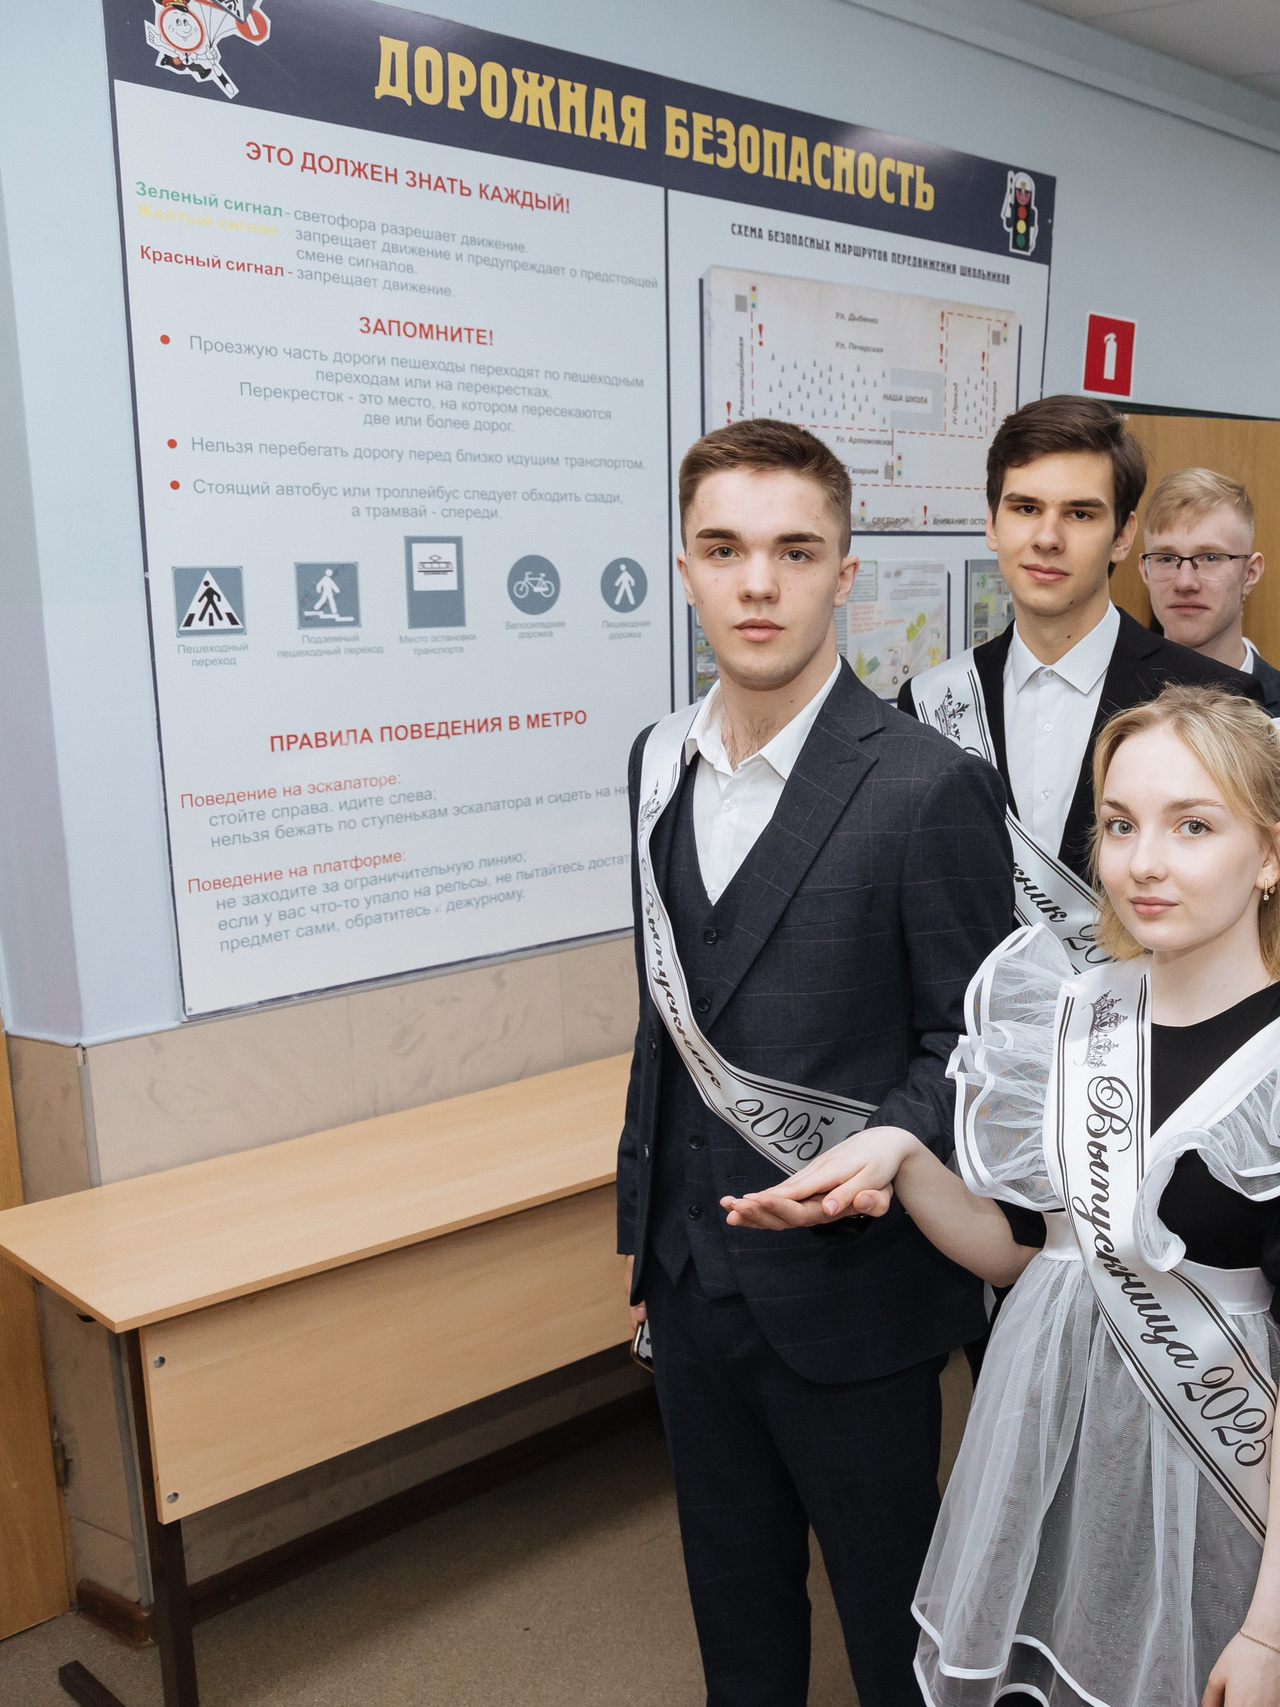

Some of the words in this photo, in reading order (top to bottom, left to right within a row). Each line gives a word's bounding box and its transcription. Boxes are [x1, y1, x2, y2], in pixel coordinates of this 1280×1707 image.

[374, 36, 648, 151] ДОРОЖНАЯ
[664, 104, 936, 212] БЕЗОПАСНОСТЬ
[245, 141, 293, 166] ЭТО
[300, 151, 397, 184] ДОЛЖЕН
[405, 169, 471, 196] ЗНАТЬ
[478, 182, 570, 213] КАЖДЫЙ!
[135, 180, 218, 207] Зеленый
[223, 198, 282, 217] сигнал
[293, 209, 375, 232] светофора
[381, 222, 456, 241] разрешает
[136, 201, 212, 226] Желтый
[218, 218, 278, 236] сигнал
[295, 229, 377, 250] запрещает
[380, 241, 450, 260] движение
[454, 251, 463, 261] и
[467, 253, 565, 275] предупреждает
[568, 267, 577, 277] о
[580, 269, 658, 288] предстоящей
[296, 249, 343, 265] смене
[348, 256, 417, 274] сигналов.
[730, 222, 763, 239] СХЕМА
[767, 229, 830, 251] БЕЗОПАСНЫХ
[834, 241, 887, 262] МАРШРУТОВ
[891, 252, 956, 274] ПЕРЕДВИЖЕНИЯ
[959, 265, 1010, 284] ШКОЛЬНИКОВ
[140, 244, 220, 269] Красный
[225, 260, 283, 276] сигнал
[296, 269, 378, 287] запрещает
[359, 316, 492, 345] ЗАПОМНИТЕ!
[189, 334, 278, 359] Проезжую
[282, 347, 328, 361] часть
[332, 351, 386, 366] дороги
[390, 356, 465, 374] пешеходы
[469, 363, 540, 379] переходят
[544, 369, 560, 380] по
[563, 371, 644, 387] пешеходным
[239, 381, 344, 402] Перекресток
[358, 393, 383, 405] это
[440, 399, 456, 410] на
[461, 400, 517, 415] котором
[521, 404, 611, 419] пересекаются
[315, 370, 399, 387] переходам
[404, 377, 431, 388] или
[435, 379, 452, 390] на
[457, 381, 551, 397] перекрестках.
[882, 393, 903, 402] НАША
[362, 413, 390, 426] две
[394, 415, 422, 426] или
[426, 413, 469, 429] более
[473, 419, 514, 433] дорог.
[191, 436, 253, 453] Нельзя
[258, 441, 348, 458] перебегать
[352, 447, 404, 463] дорогу
[408, 449, 452, 463] перед
[455, 448, 502, 463] близко
[506, 454, 559, 467] идущим
[563, 456, 645, 470] транспортом.
[192, 478, 270, 497] Стоящий
[275, 481, 338, 500] автобус
[342, 486, 370, 497] или
[375, 485, 459, 502] троллейбус
[463, 489, 517, 503] следует
[521, 488, 581, 503] обходить
[350, 506, 360, 517] а
[364, 504, 426, 520] трамвай
[440, 507, 501, 521] спереди.
[176, 641, 248, 654] Пешеходный
[276, 646, 341, 657] пешеходный
[343, 645, 384, 656] переход
[301, 632, 359, 644] Подземный
[191, 657, 236, 668] переход
[270, 727, 373, 752] ПРАВИЛА
[380, 716, 502, 742] ПОВЕДЕНИЯ
[508, 715, 520, 730] В
[526, 709, 586, 728] МЕТРО
[180, 787, 276, 808] Поведение
[282, 784, 302, 796] на
[307, 774, 402, 794] эскалаторе:
[208, 808, 266, 826] стойте
[338, 795, 384, 811] идите
[210, 829, 269, 847] нельзя
[274, 822, 333, 839] бежать
[338, 818, 356, 830] по
[361, 807, 448, 829] ступенькам
[452, 796, 531, 816] эскалатора
[535, 795, 543, 805] и
[547, 790, 592, 804] сидеть
[595, 787, 610, 797] на
[614, 783, 629, 795] ни
[187, 869, 283, 893] Поведение
[288, 865, 307, 878] на
[312, 849, 408, 874] платформе:
[216, 897, 236, 910] не
[242, 884, 316, 906] заходите
[322, 880, 339, 893] за
[343, 859, 474, 890] ограничительную
[217, 914, 258, 931] если
[263, 911, 272, 927] у
[277, 906, 306, 921] вас
[310, 897, 360, 914] что-то
[363, 889, 409, 910] упало
[413, 885, 431, 897] на
[495, 872, 512, 884] не
[516, 861, 584, 880] пытайтесь
[587, 853, 630, 871] достат
[219, 929, 290, 953] предмет
[344, 905, 431, 929] обратитесь
[726, 1098, 836, 1162] 2025
[1072, 1075, 1199, 1369] Выпускница
[1177, 1366, 1272, 1467] 2025
